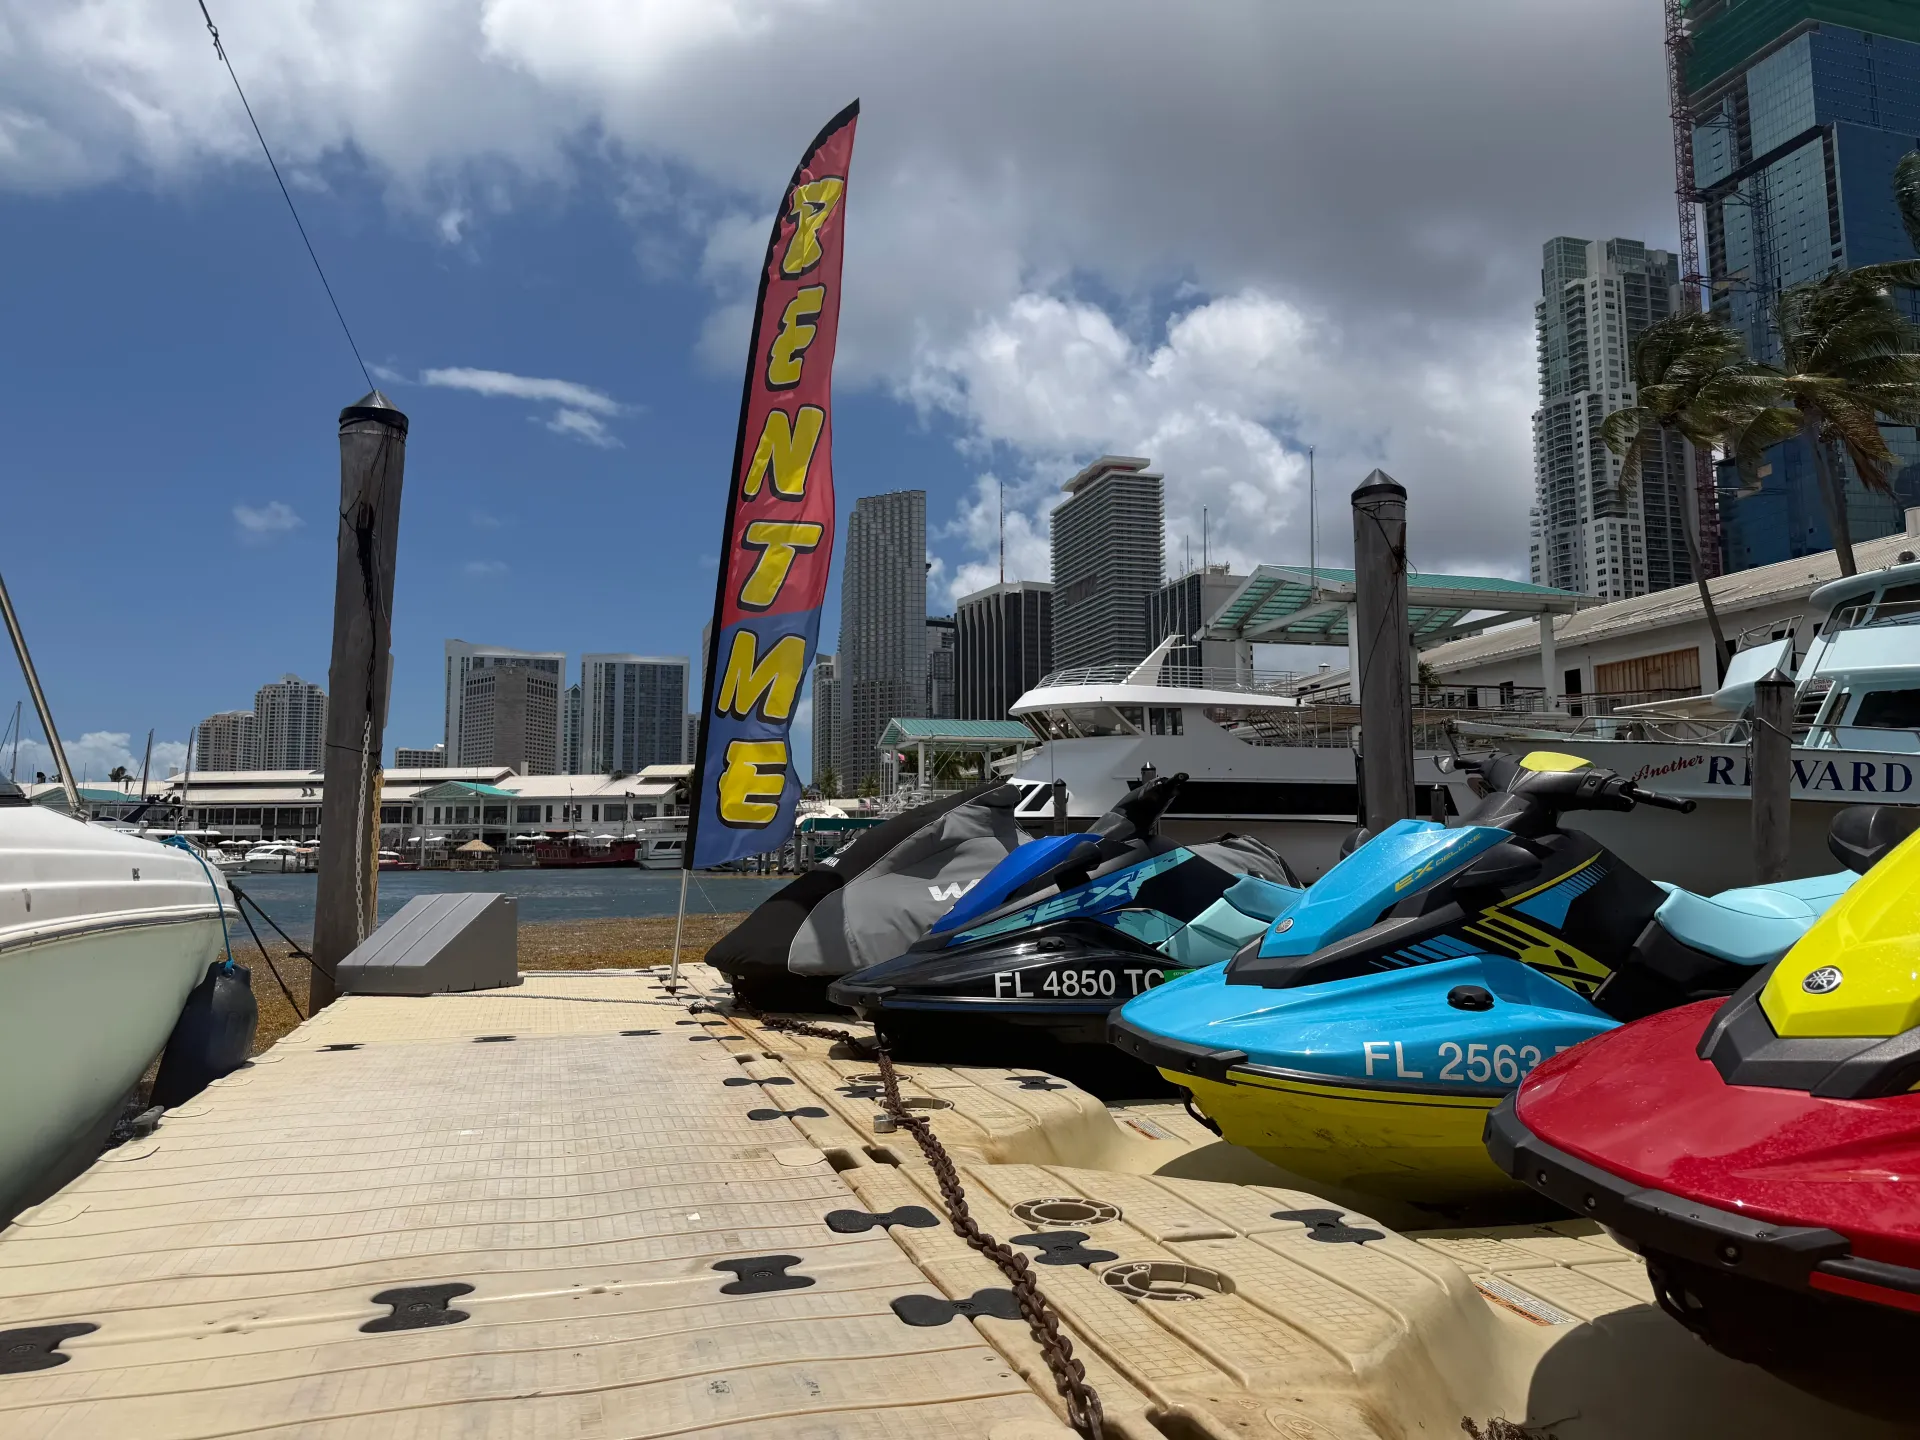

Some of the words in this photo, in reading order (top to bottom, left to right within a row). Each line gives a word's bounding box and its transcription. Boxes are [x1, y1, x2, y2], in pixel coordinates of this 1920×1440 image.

[1631, 755, 1705, 782] Another
[1395, 860, 1434, 892] EX
[994, 971, 1034, 998] FL
[1042, 969, 1116, 997] 4850
[1362, 1041, 1423, 1079] FL
[1438, 1042, 1541, 1084] 2563
